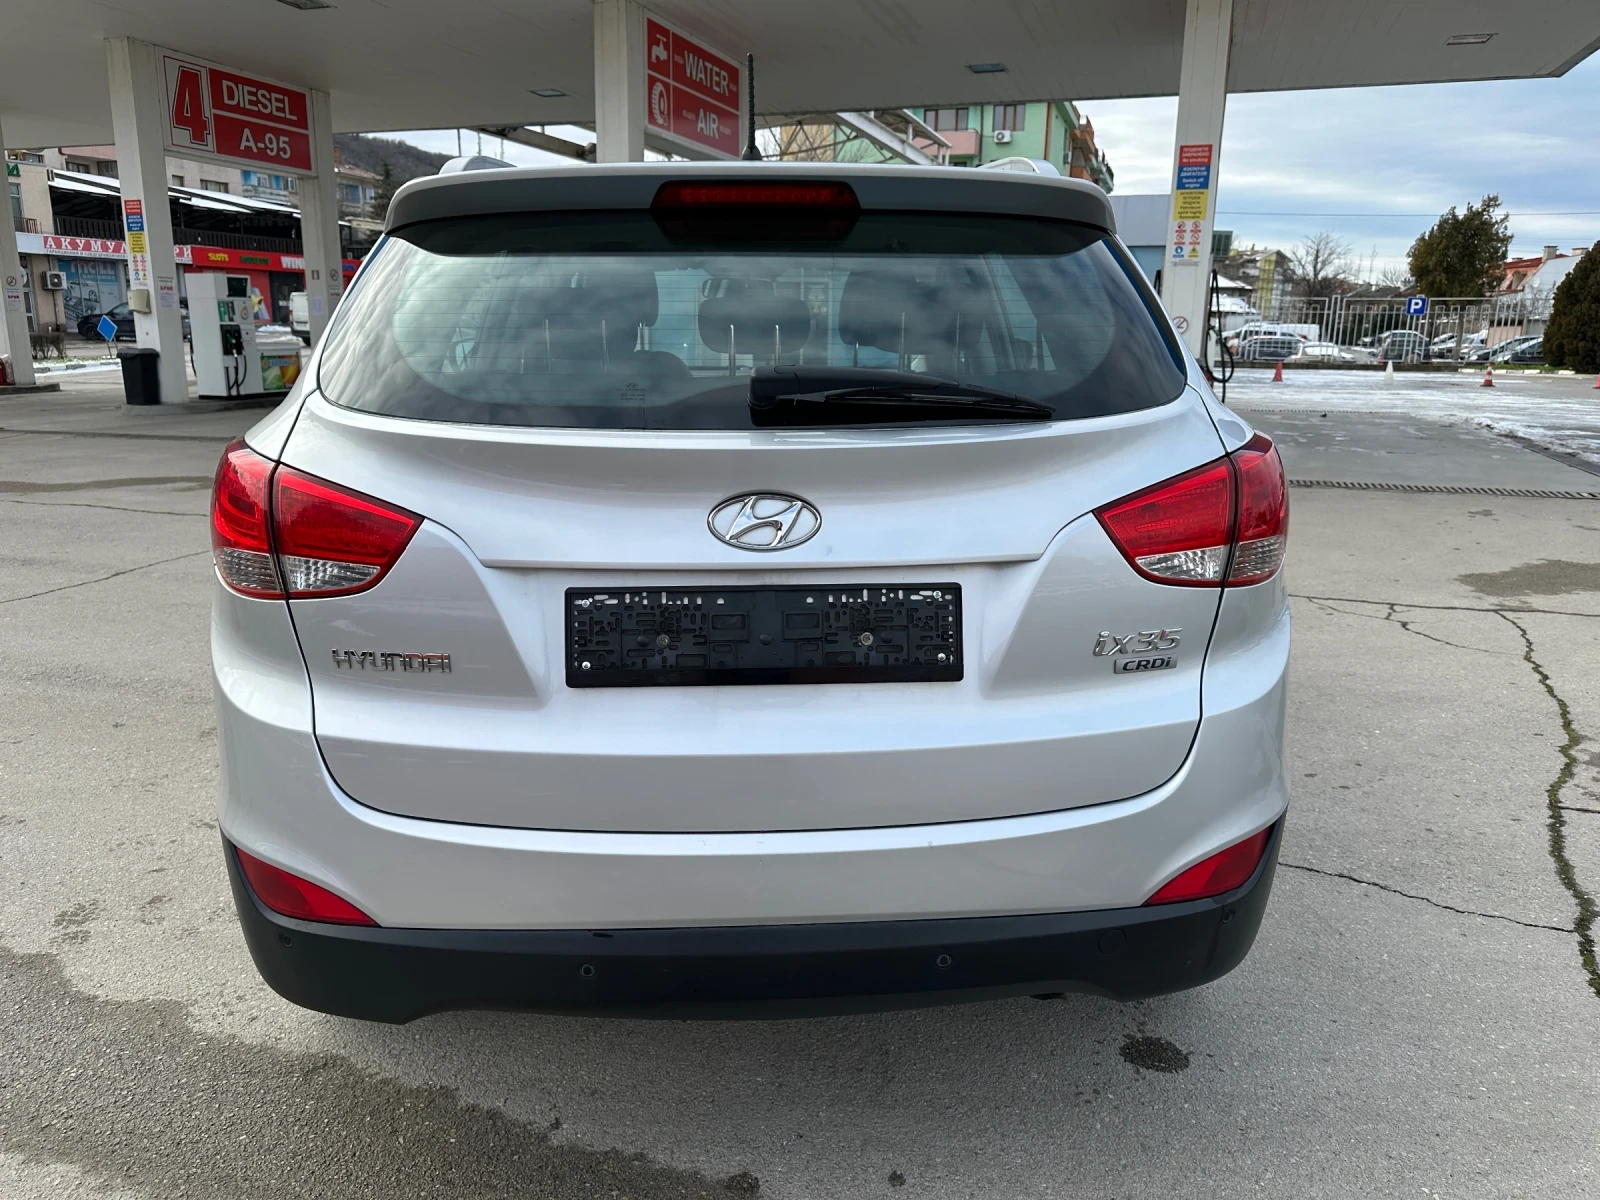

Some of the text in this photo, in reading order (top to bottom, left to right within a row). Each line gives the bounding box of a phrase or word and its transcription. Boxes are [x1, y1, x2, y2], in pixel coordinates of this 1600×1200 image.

[684, 50, 729, 97] WATER
[172, 65, 210, 147] 4
[222, 79, 298, 121] DIESEL
[697, 108, 719, 140] AIR
[240, 128, 291, 160] A-95
[208, 252, 229, 262] SLOTS
[281, 255, 306, 269] WIN
[1410, 299, 1422, 313] P
[1093, 627, 1183, 656] ix35
[331, 648, 451, 673] HYUNDAI
[1122, 657, 1172, 671] CRDi
